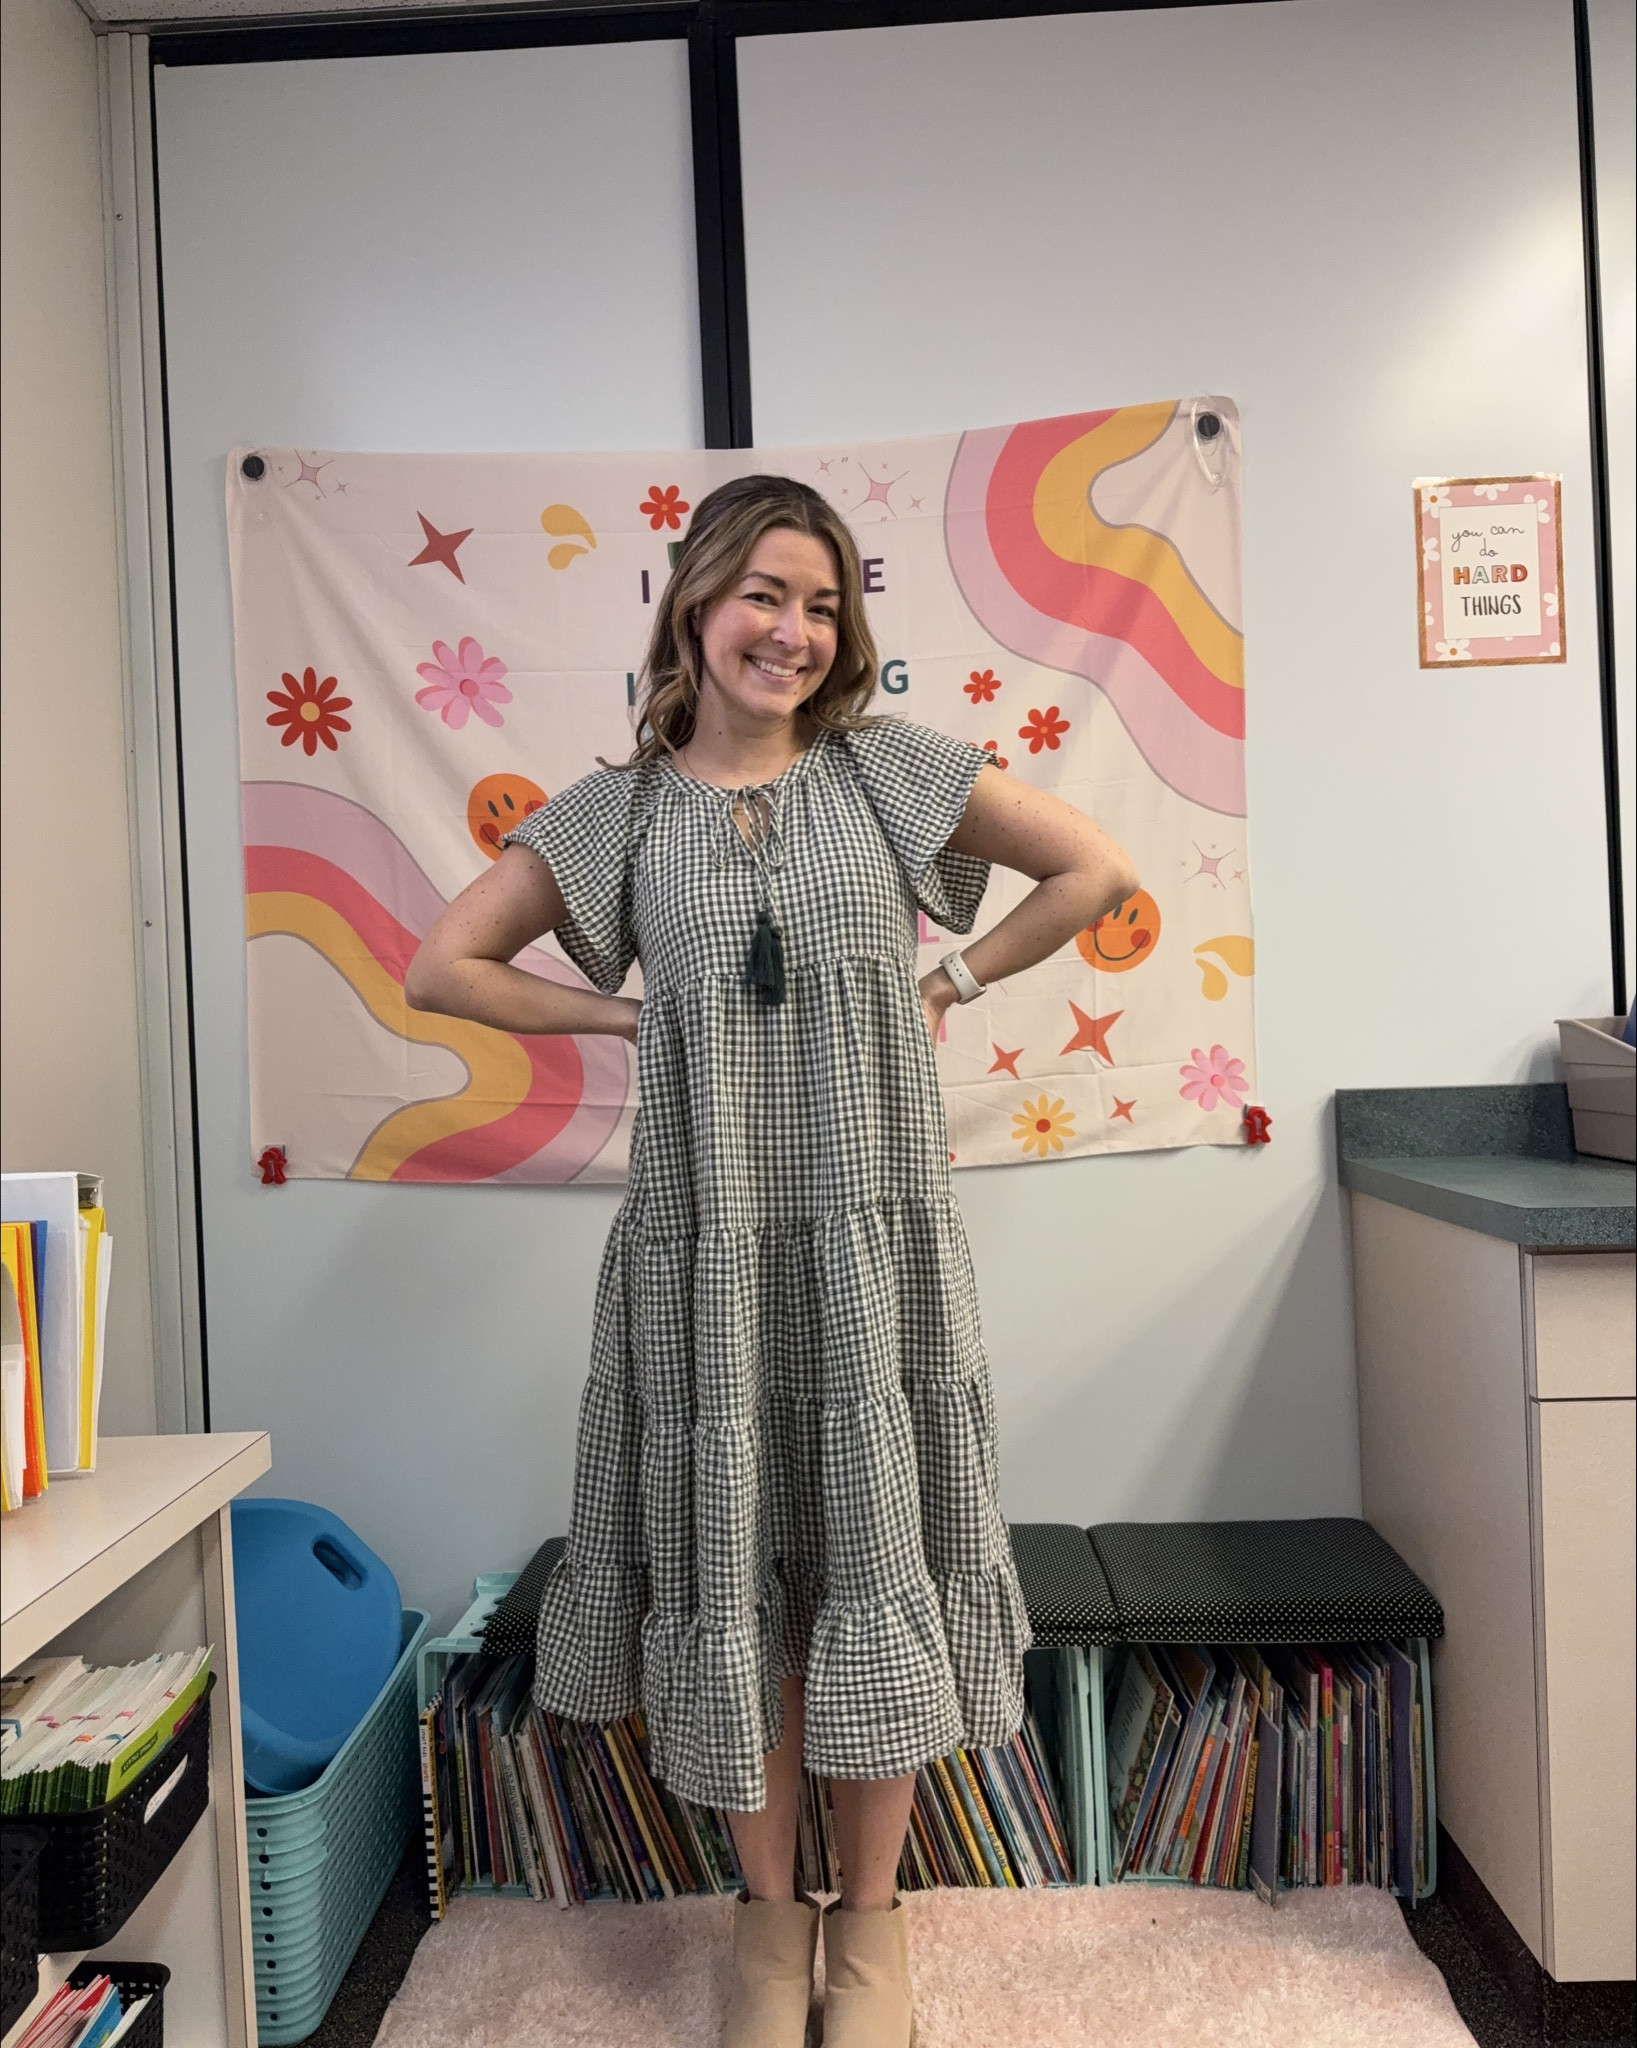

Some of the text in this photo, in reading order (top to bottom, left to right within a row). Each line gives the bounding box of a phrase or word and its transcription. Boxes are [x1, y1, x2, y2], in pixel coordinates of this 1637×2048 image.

[1451, 525, 1524, 552] you can
[1479, 537, 1499, 557] do
[1453, 564, 1528, 585] HARD
[1461, 594, 1522, 617] THINGS
[938, 1764, 948, 1782] LLAMA
[945, 1783, 955, 1801] LLAMA
[1191, 1784, 1200, 1796] ARE
[961, 1761, 1006, 1869] BUILDER BROTHERS BIG PLANS
